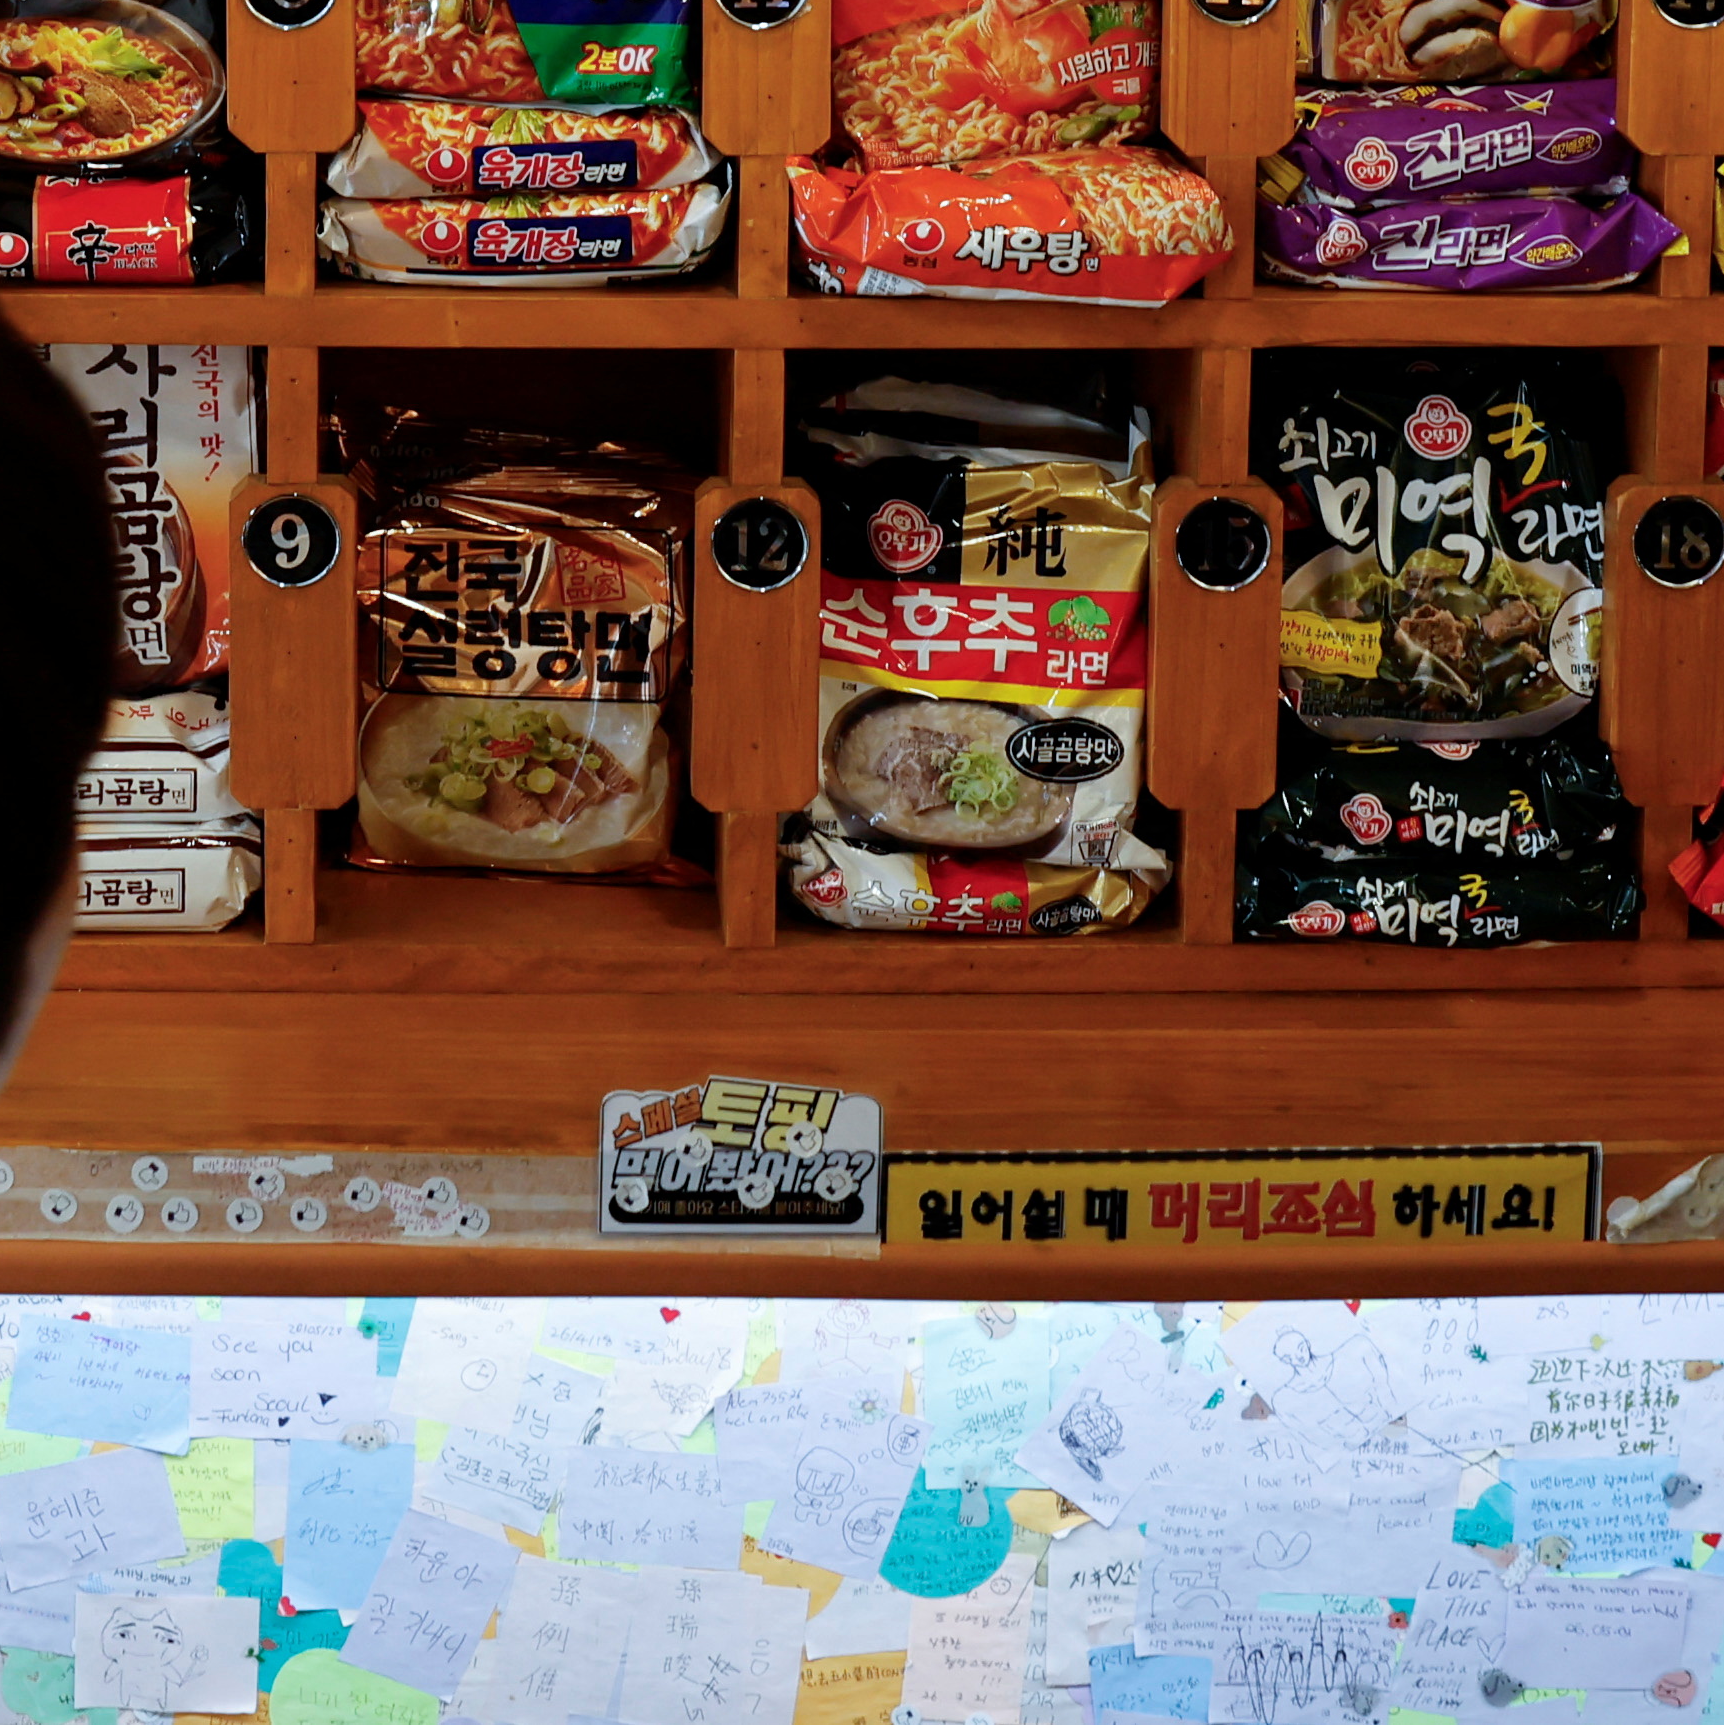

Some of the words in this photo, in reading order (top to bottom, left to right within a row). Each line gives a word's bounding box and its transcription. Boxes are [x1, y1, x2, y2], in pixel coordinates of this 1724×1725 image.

[577, 41, 657, 77] 2분OK
[1058, 44, 1130, 86] 시원하고
[113, 257, 158, 270] BLACK
[1278, 416, 1376, 473] 쇠고기
[1420, 427, 1460, 446] 오뚜기
[273, 512, 313, 570] 9
[731, 517, 790, 572] 12
[878, 529, 928, 554] 오뚜기
[982, 505, 1068, 579] 純
[1655, 520, 1712, 571] 18
[819, 586, 1038, 674] 순후추
[1046, 649, 1109, 687] 라면
[1016, 733, 1118, 765] 사골곰탕맛
[918, 1187, 1067, 1242] 일어설
[1082, 1187, 1131, 1241] 때
[1148, 1179, 1376, 1244] 머리조심
[1392, 1184, 1555, 1237] 하세요!
[212, 1333, 258, 1353] See
[278, 1339, 314, 1363] you
[210, 1368, 261, 1382] soon
[254, 1392, 311, 1413] Seoul
[1426, 1561, 1491, 1589] LOVE
[1445, 1596, 1491, 1617] THIS
[1415, 1620, 1475, 1651] PLACE
